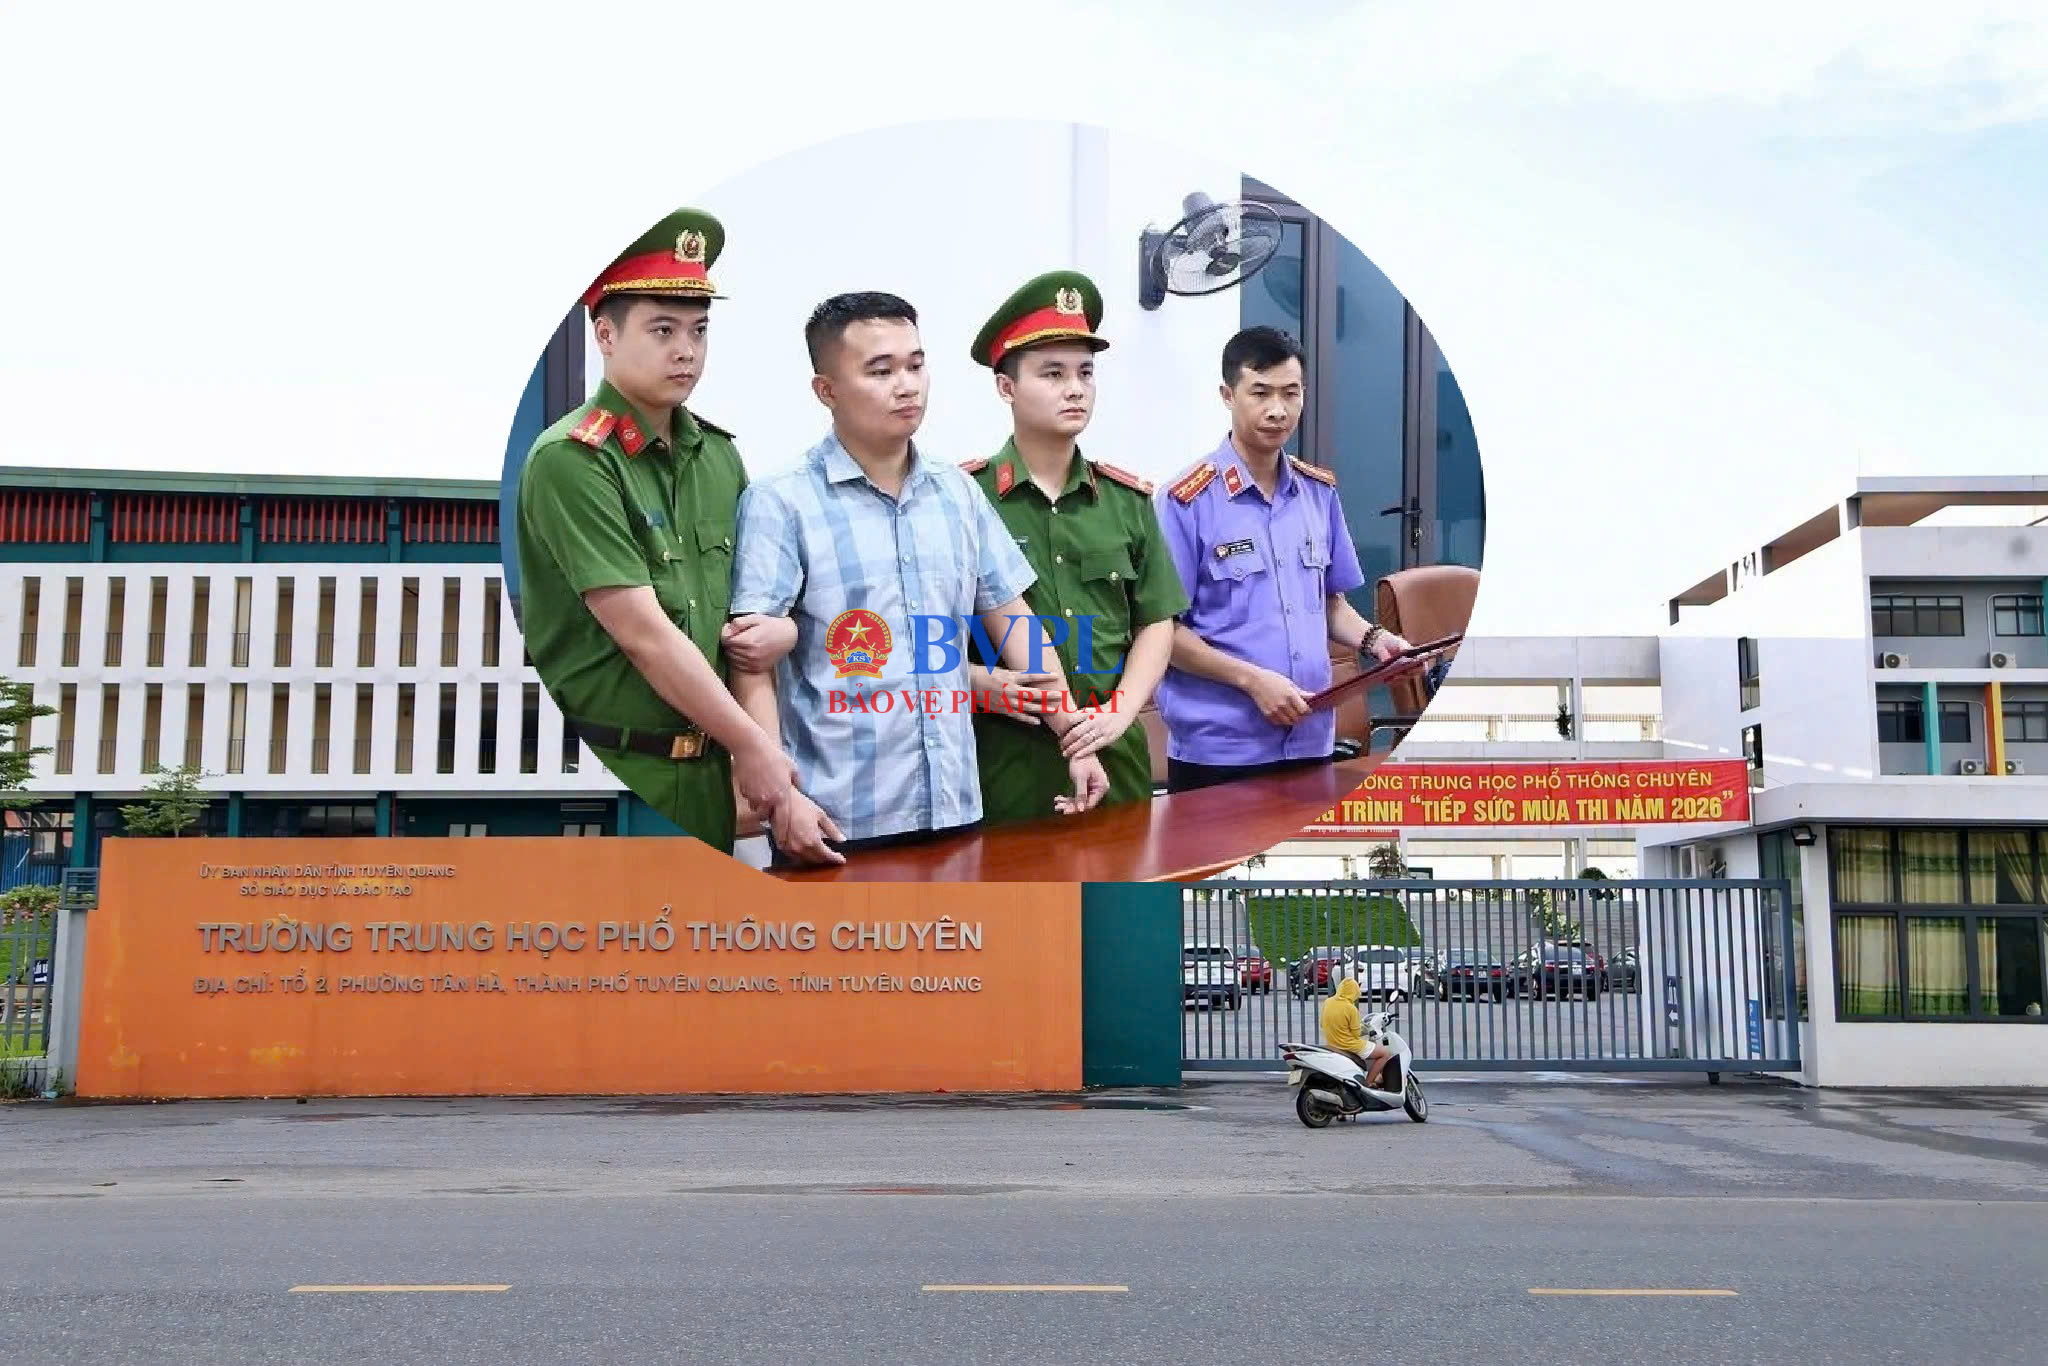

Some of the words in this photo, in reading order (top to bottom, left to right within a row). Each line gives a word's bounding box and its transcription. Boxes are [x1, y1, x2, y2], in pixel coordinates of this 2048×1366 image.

[1409, 775, 1472, 790] TRUNG
[1478, 775, 1517, 793] HỌC
[1523, 767, 1561, 790] PHỔ
[1566, 770, 1630, 789] THÔNG
[1636, 768, 1713, 787] CHUYÊN
[1341, 795, 1404, 823] TRÌNH
[1473, 794, 1516, 822] SỨC
[1522, 795, 1570, 822] MÙA
[1575, 799, 1609, 821] THI
[1615, 793, 1665, 820] NĂM
[1671, 790, 1734, 819] 2026”
[222, 866, 249, 878] BAN
[253, 864, 290, 878] NHÂN
[294, 863, 322, 878] DÂN
[360, 863, 405, 878] TUYÊN
[408, 865, 456, 879] QUANG
[263, 882, 297, 896] GIÁO
[299, 884, 328, 899] DỤC
[332, 882, 349, 896] VÀ
[352, 882, 382, 896] ĐÀO
[385, 884, 414, 899] TẠO
[197, 913, 353, 952] TRƯỜNG
[365, 921, 495, 952] TRUNG
[506, 920, 587, 959] HỌC
[598, 903, 675, 951] PHỔ
[686, 914, 817, 951] THÔNG
[831, 914, 983, 951] CHUYÊN
[194, 976, 229, 998] ĐỊA
[280, 966, 307, 993] TỔ
[339, 971, 424, 993] PHƯỜNG
[432, 973, 469, 993] TÂN
[514, 971, 583, 993] THÀNH
[588, 968, 631, 992] PHỐ
[635, 972, 700, 993] TUYÊN
[706, 975, 784, 995] QUANG,
[789, 969, 832, 992] TỈNH
[838, 972, 904, 992] TUYÊN
[910, 975, 982, 993] QUANG
